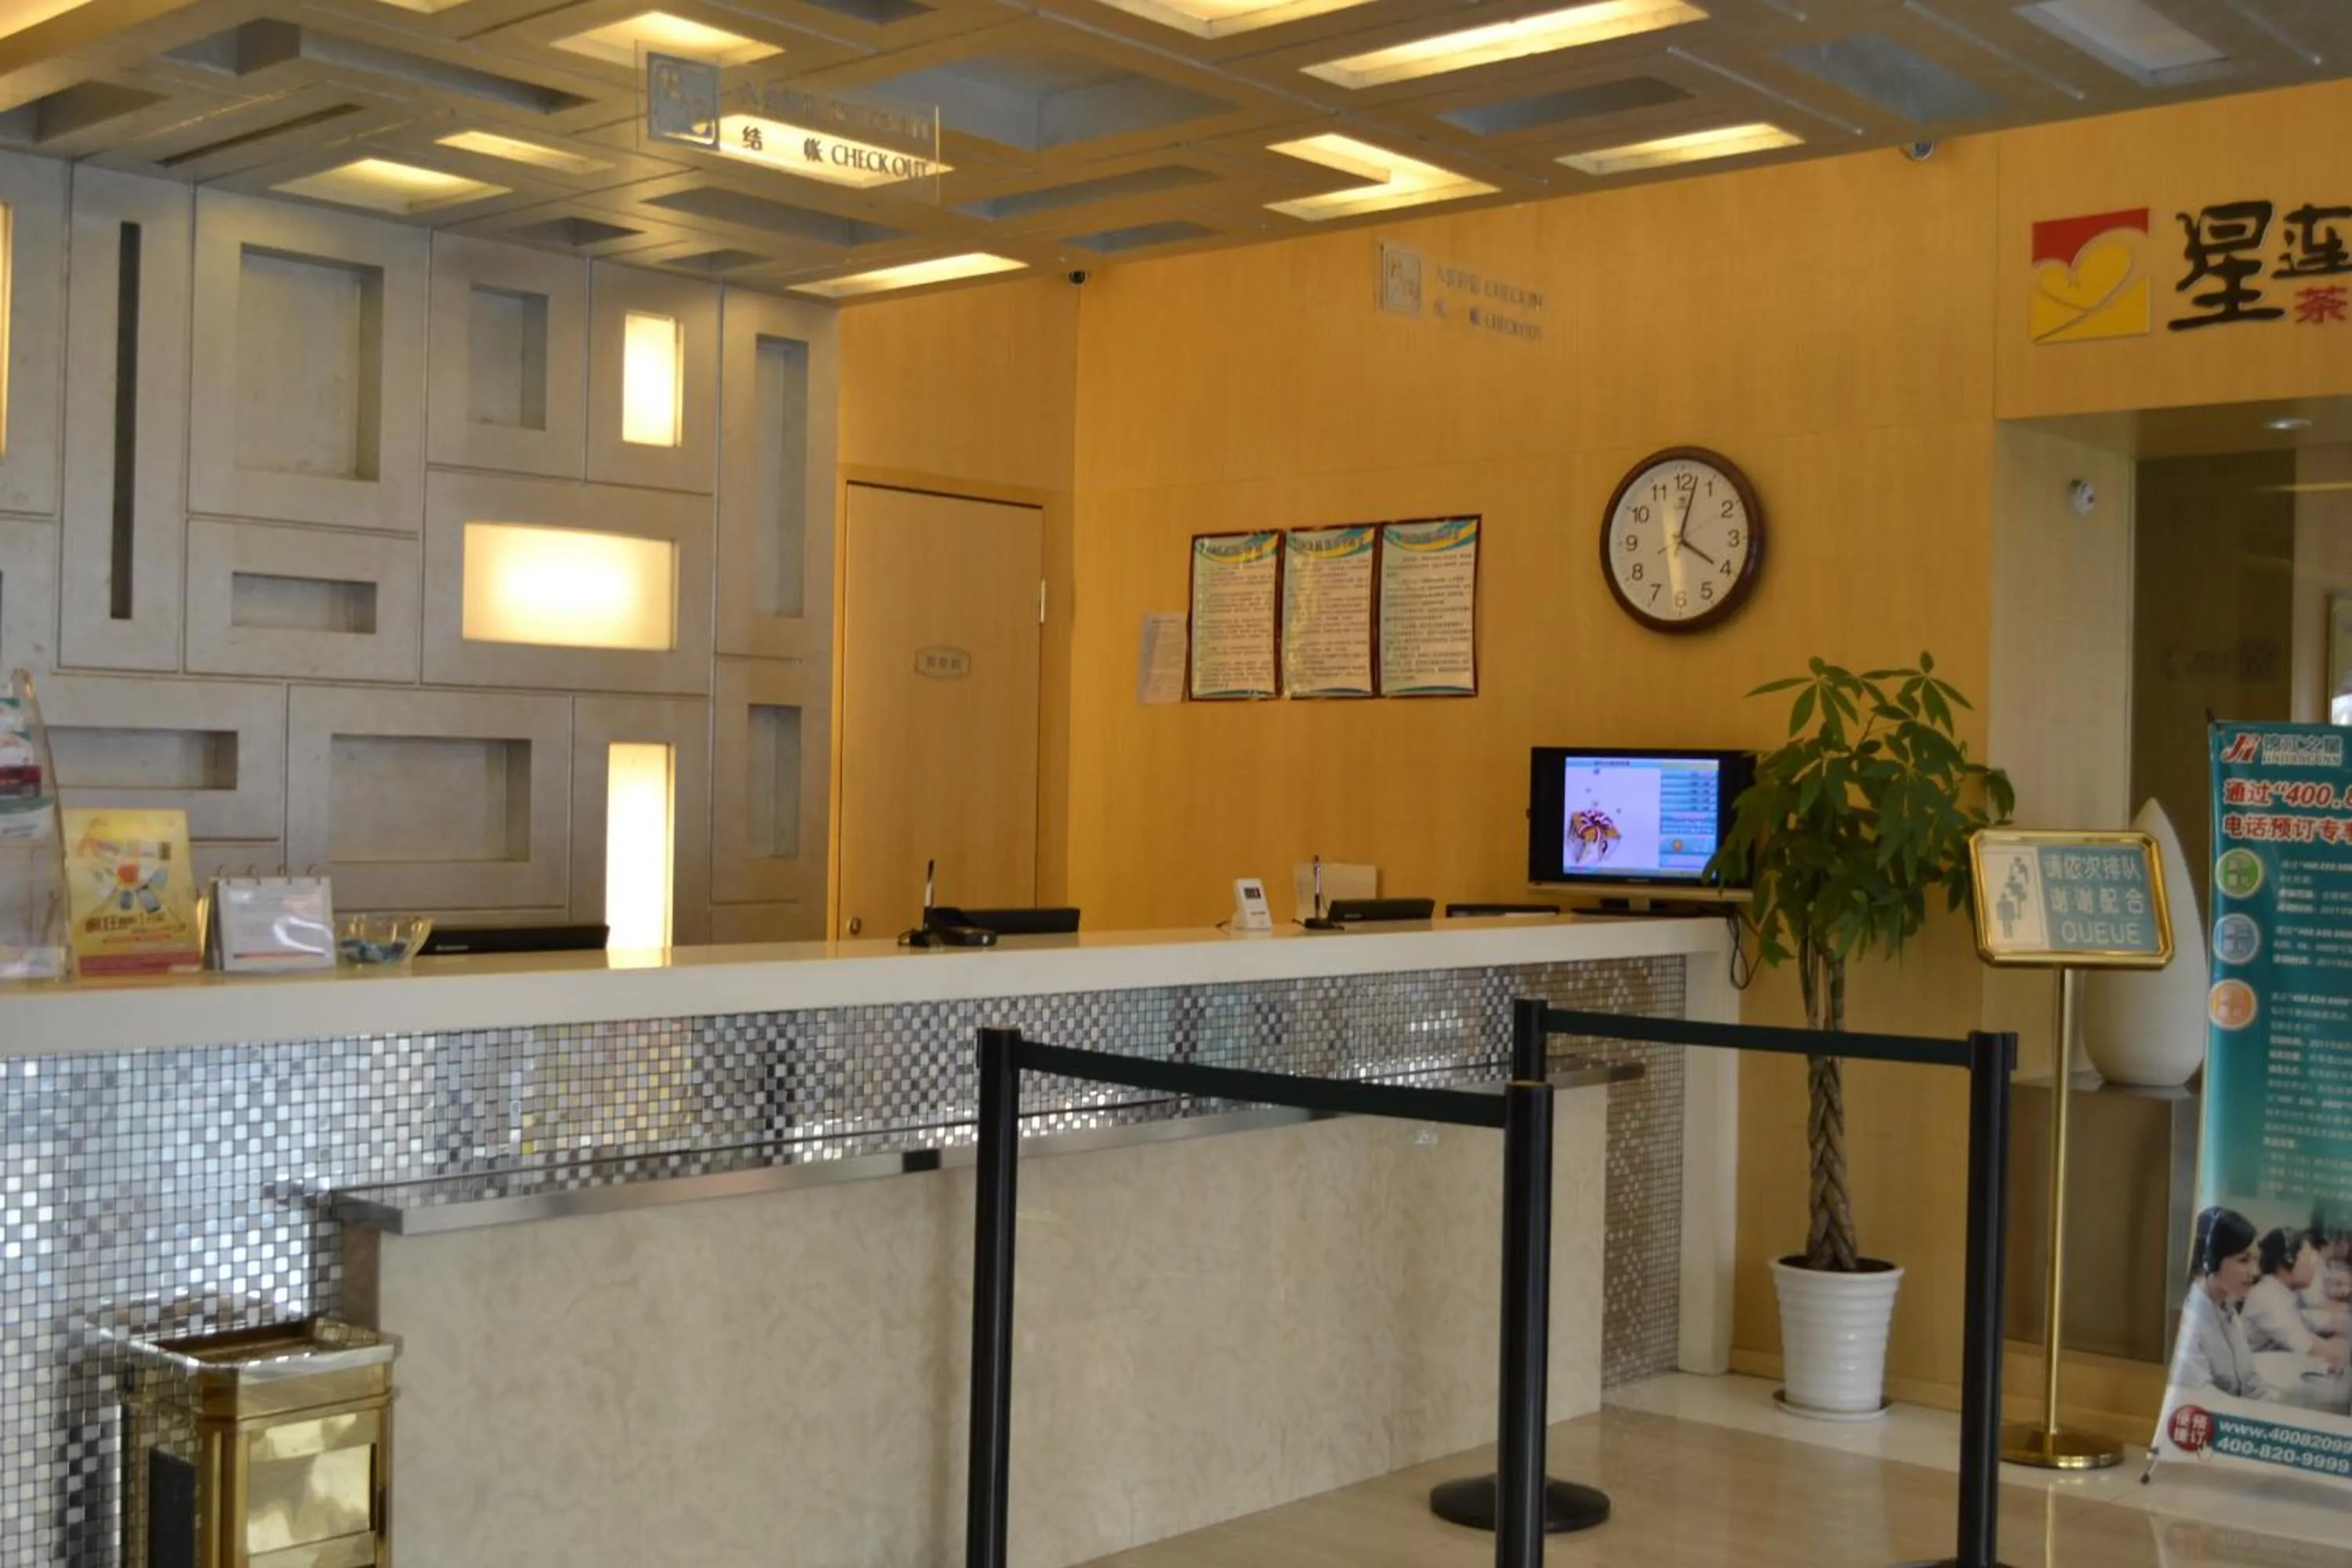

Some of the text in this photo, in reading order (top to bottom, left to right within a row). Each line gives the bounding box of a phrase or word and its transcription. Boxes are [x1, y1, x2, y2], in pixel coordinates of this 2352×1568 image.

[831, 144, 890, 175] CHECK
[891, 157, 930, 178] OUT
[1674, 474, 1693, 491] 12
[1706, 480, 1713, 498] 1
[1652, 484, 1667, 502] 11
[1632, 506, 1650, 523] 10
[1720, 500, 1733, 518] 2
[1625, 535, 1638, 552] 9
[1728, 529, 1740, 548] 3
[1632, 563, 1644, 581] 8
[1719, 559, 1732, 577] 4
[1650, 583, 1662, 601] 7
[1675, 590, 1687, 608] 6
[1700, 582, 1713, 600] 5
[2050, 887, 2145, 914] 谢谢配合
[2061, 920, 2142, 945] QUEUE
[2218, 1437, 2350, 1473] 400-820-9999
